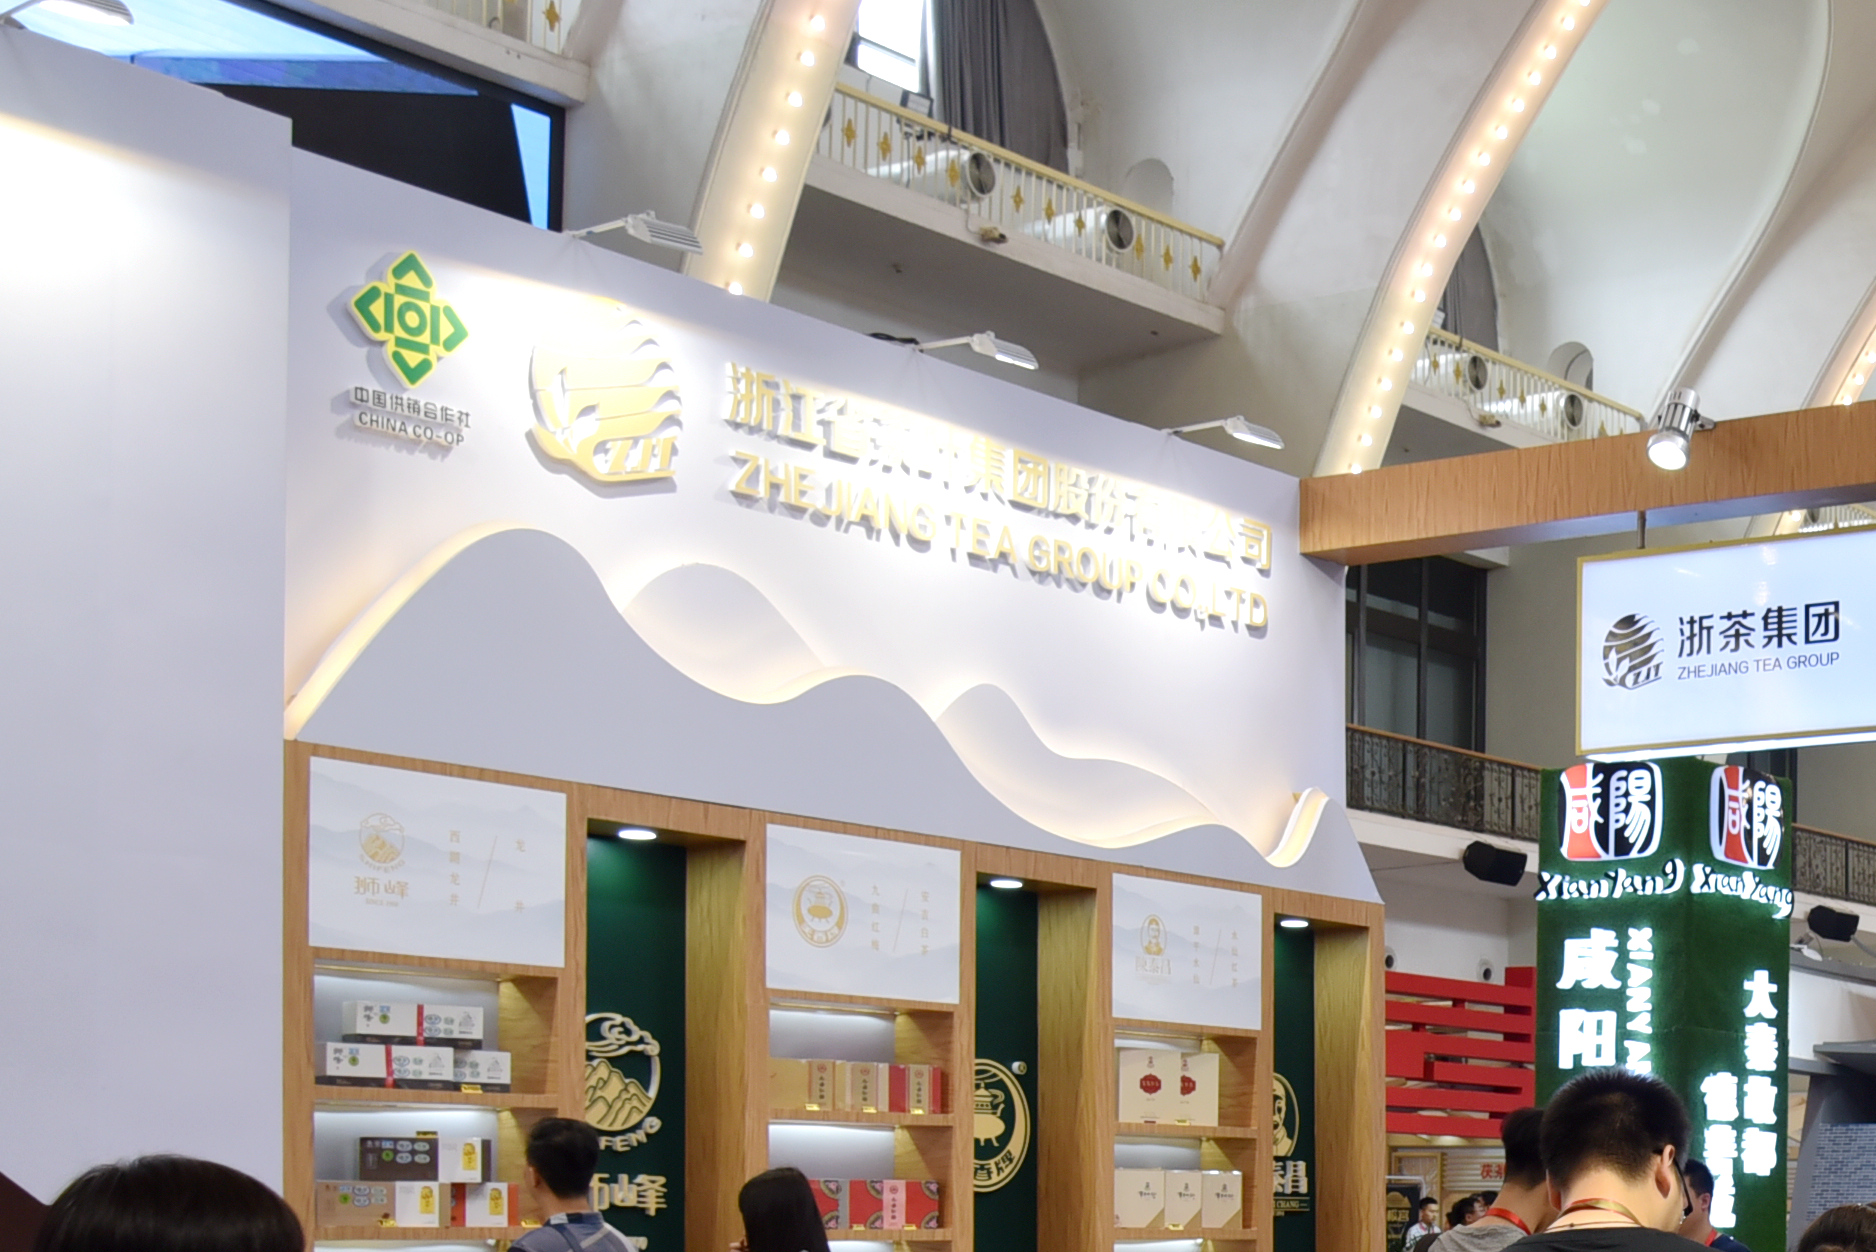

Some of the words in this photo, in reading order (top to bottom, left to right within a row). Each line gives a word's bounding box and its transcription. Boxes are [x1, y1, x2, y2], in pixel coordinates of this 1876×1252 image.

[354, 386, 471, 429] 中国供销合作社
[358, 411, 409, 436] CHINA
[412, 424, 465, 447] CO-OP
[729, 450, 938, 543] ZHEJIANG
[950, 512, 1019, 564] TEA
[1028, 535, 1143, 595] GROUP
[1677, 600, 1840, 658] 浙茶集团
[1677, 661, 1750, 680] ZHEJIANG
[1754, 657, 1783, 673] TEA
[1786, 651, 1840, 670] GROUP
[353, 875, 409, 900] 狮峰
[1556, 928, 1622, 1070] 咸阳
